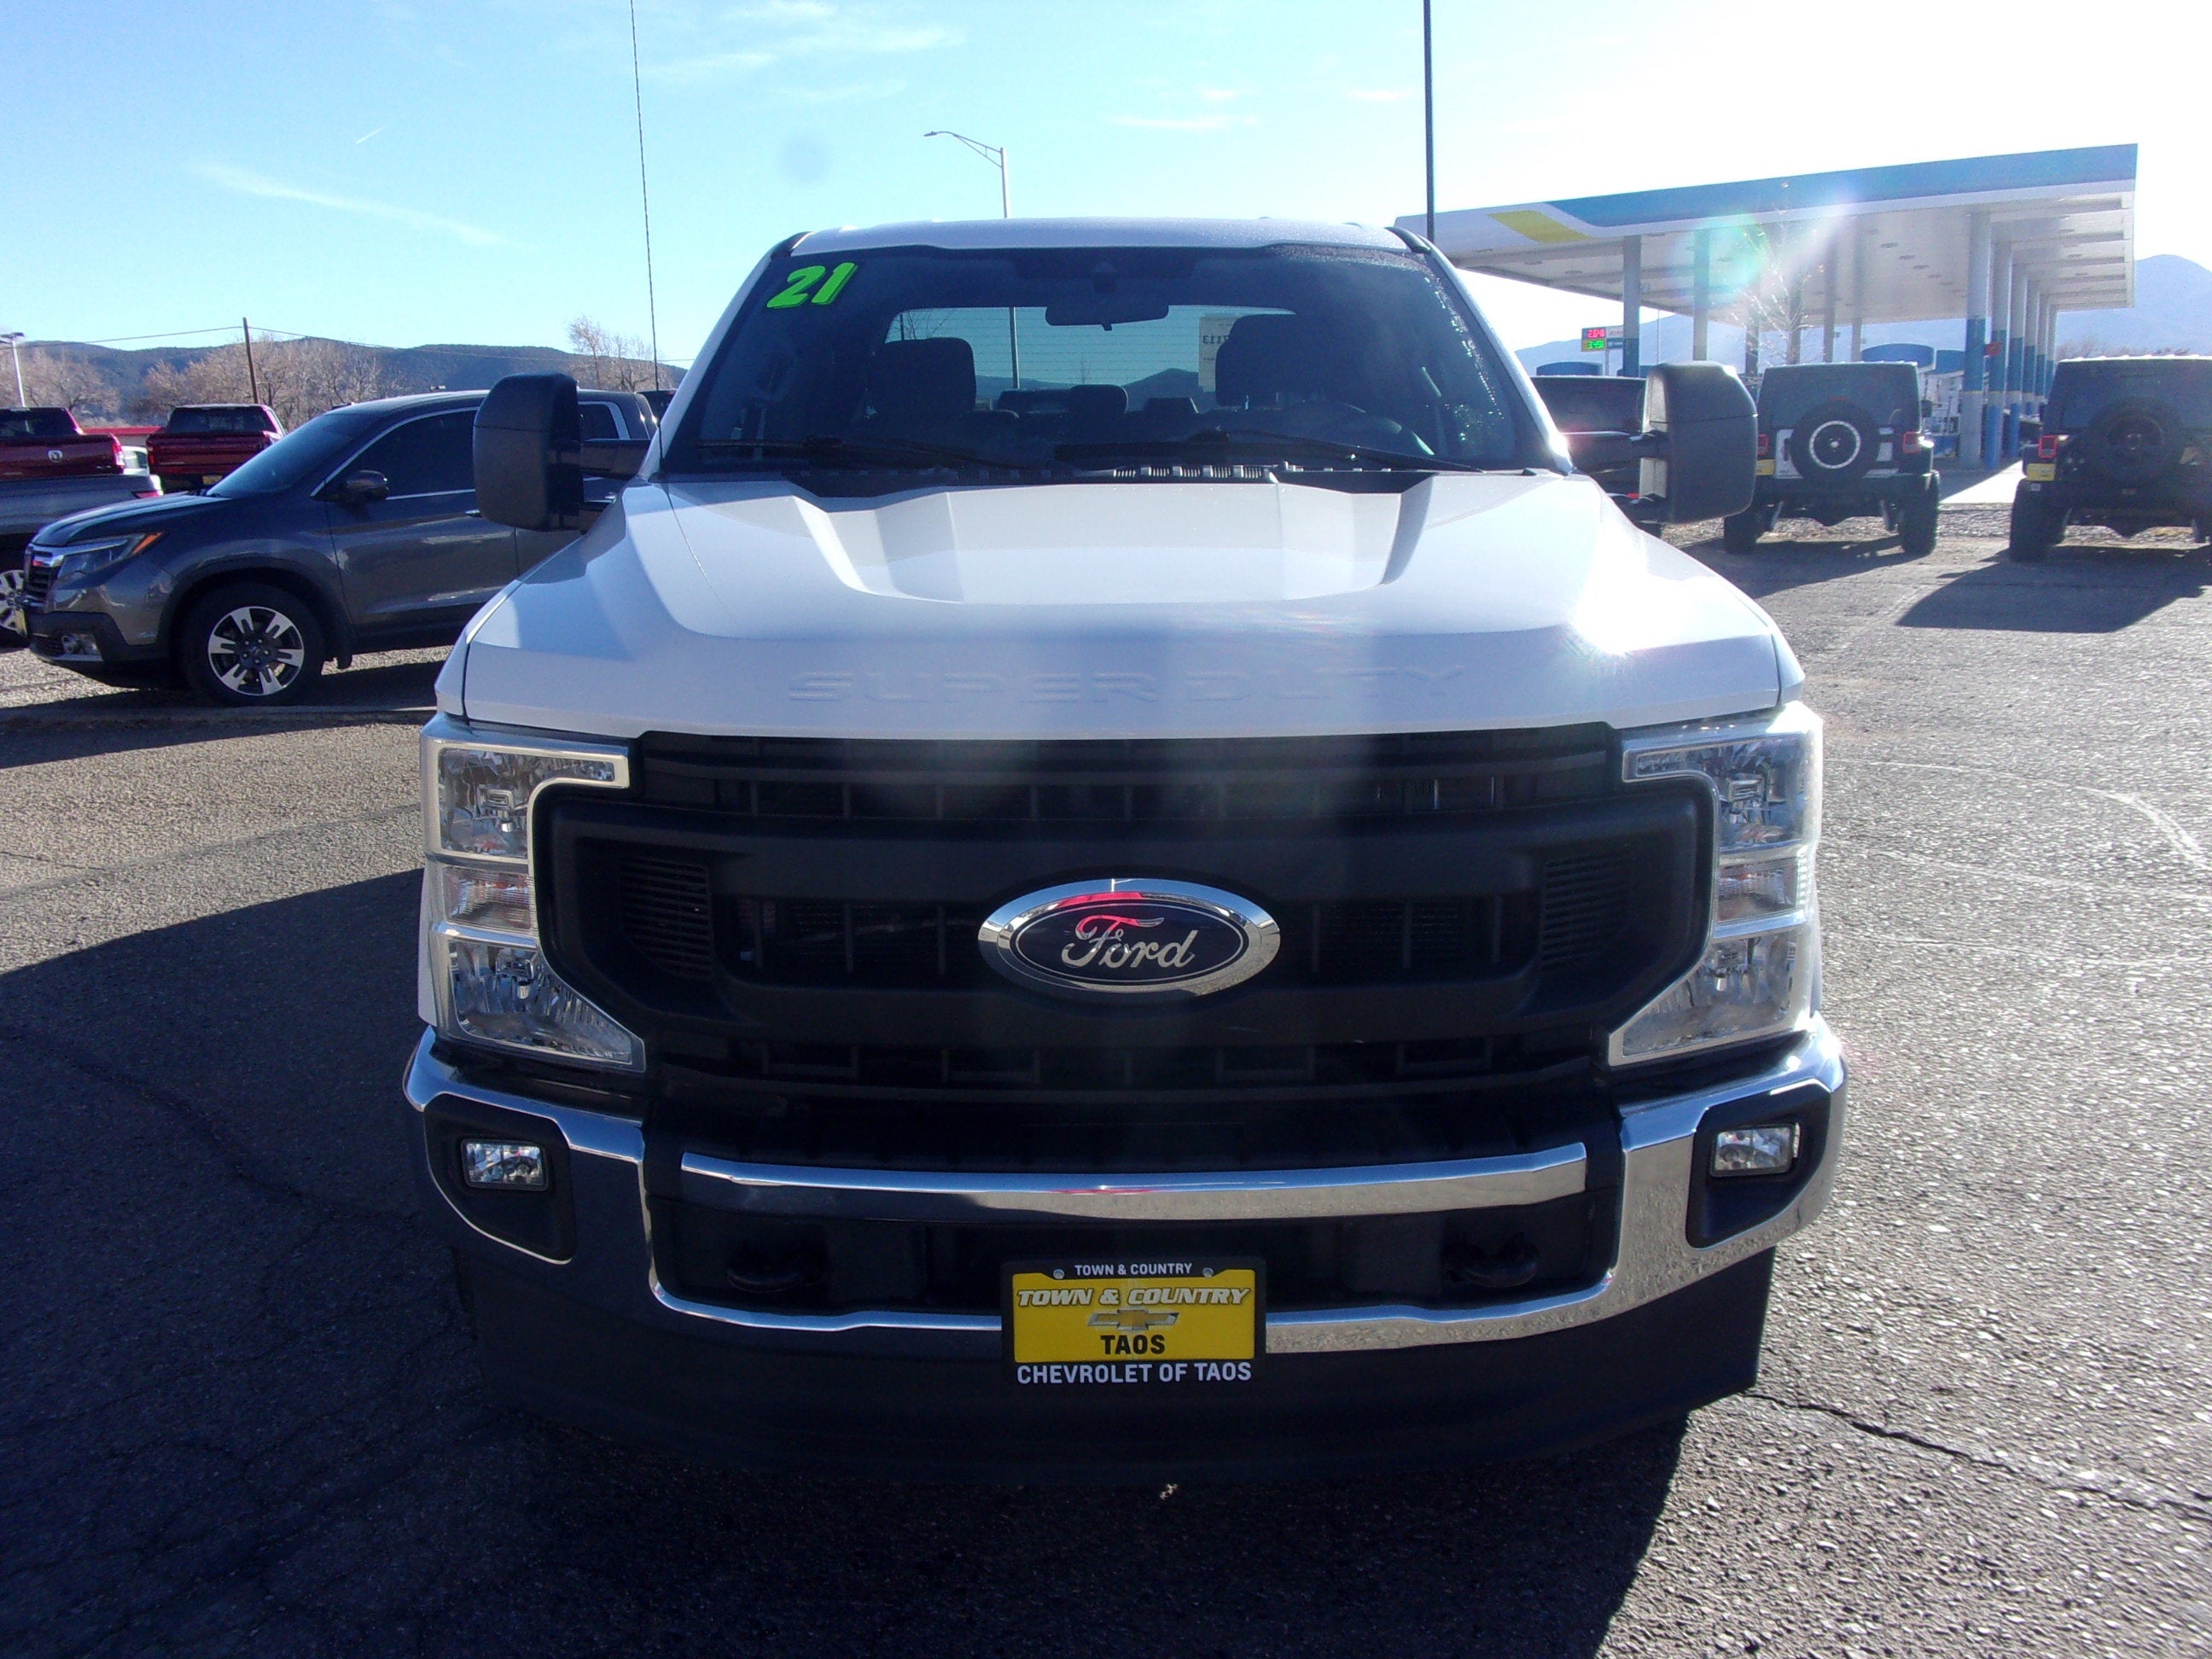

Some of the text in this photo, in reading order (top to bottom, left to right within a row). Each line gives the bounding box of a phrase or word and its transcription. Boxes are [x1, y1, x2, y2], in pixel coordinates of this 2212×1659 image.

[766, 261, 859, 309] 21
[1062, 915, 1198, 969] Ford
[1074, 1262, 1193, 1277] TOWN & COUNTRY
[1016, 1286, 1251, 1307] TOWN & COUNTRY
[1100, 1334, 1166, 1355] TAOS
[1016, 1361, 1252, 1385] CHEVROLET OF TAOS
